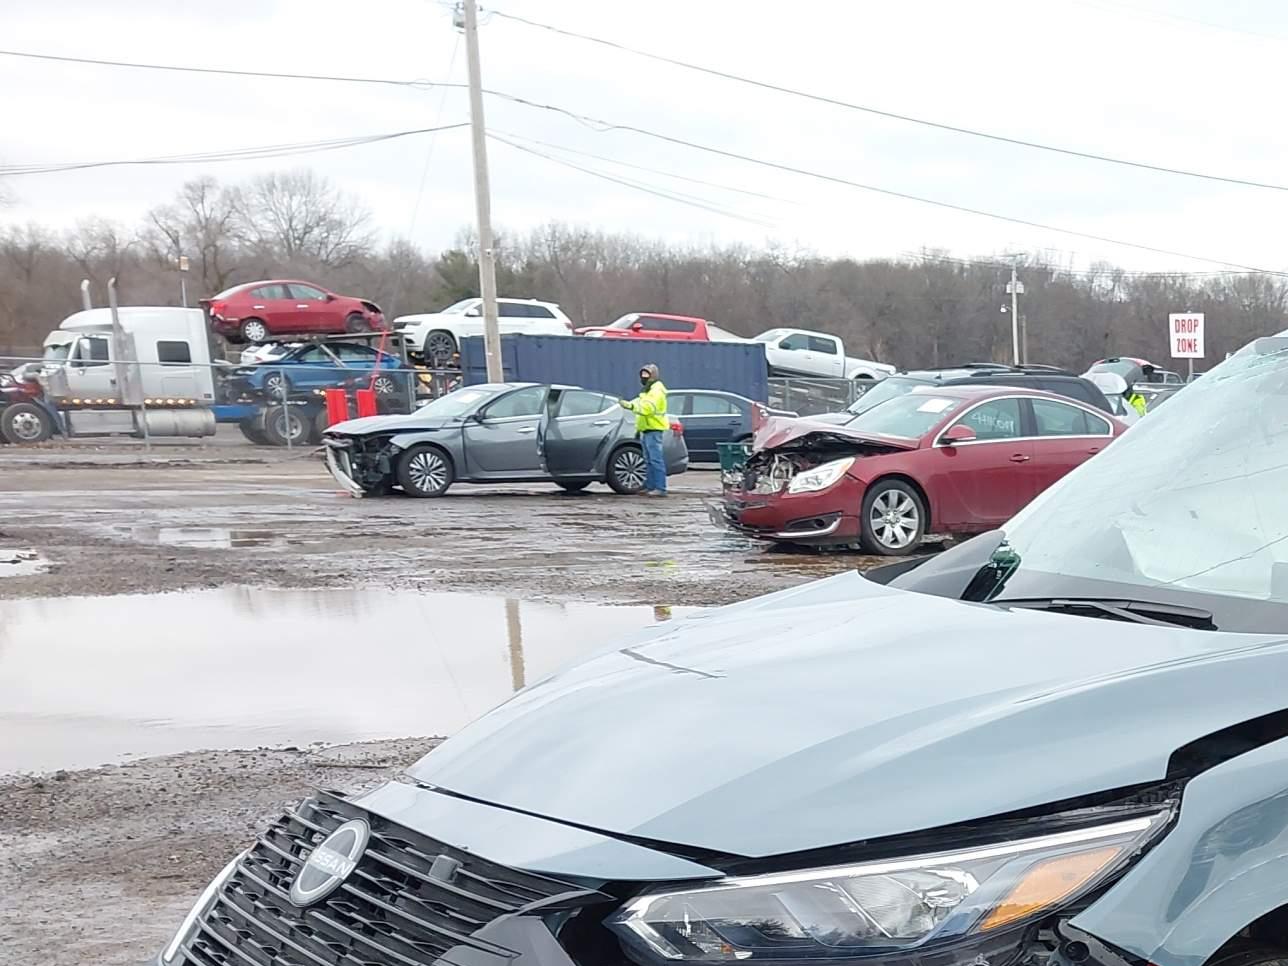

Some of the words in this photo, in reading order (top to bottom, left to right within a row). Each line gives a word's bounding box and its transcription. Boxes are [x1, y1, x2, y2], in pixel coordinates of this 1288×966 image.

[1174, 318, 1199, 334] DROP
[1176, 337, 1198, 353] ZONE
[311, 847, 352, 875] SSAN
